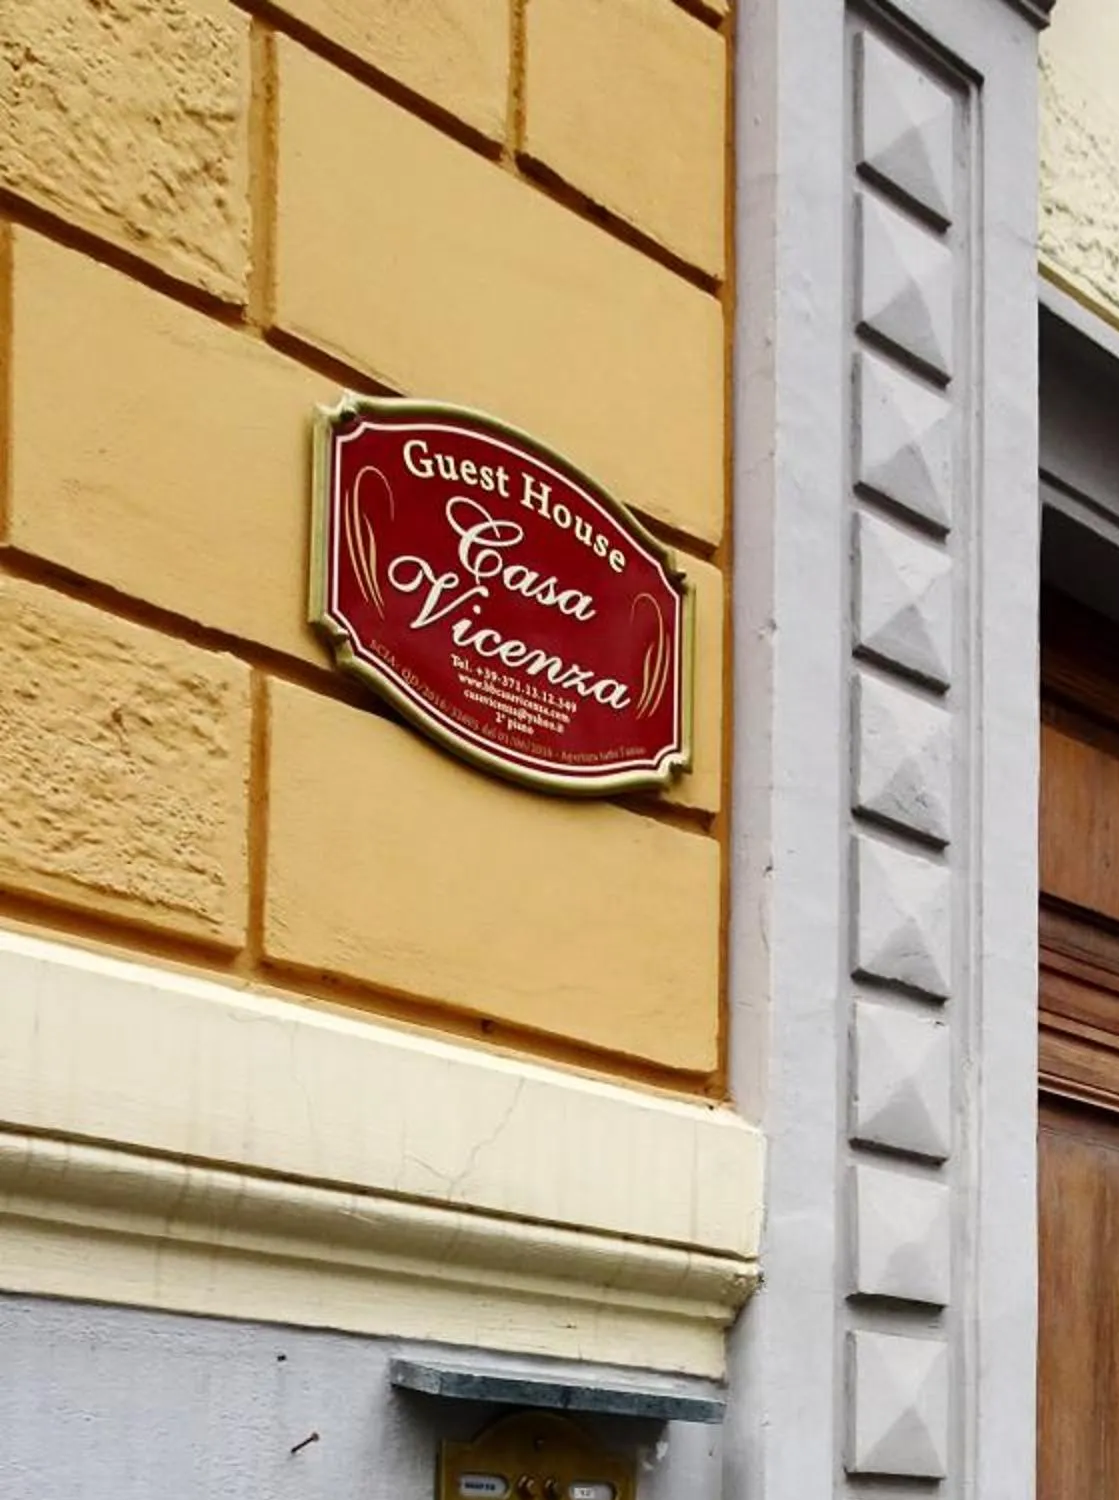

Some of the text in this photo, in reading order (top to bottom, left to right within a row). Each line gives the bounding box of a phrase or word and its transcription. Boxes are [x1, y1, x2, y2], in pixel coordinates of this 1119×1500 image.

[403, 440, 626, 573] Guest House
[446, 496, 596, 621] Casa
[388, 555, 631, 709] Vicenza
